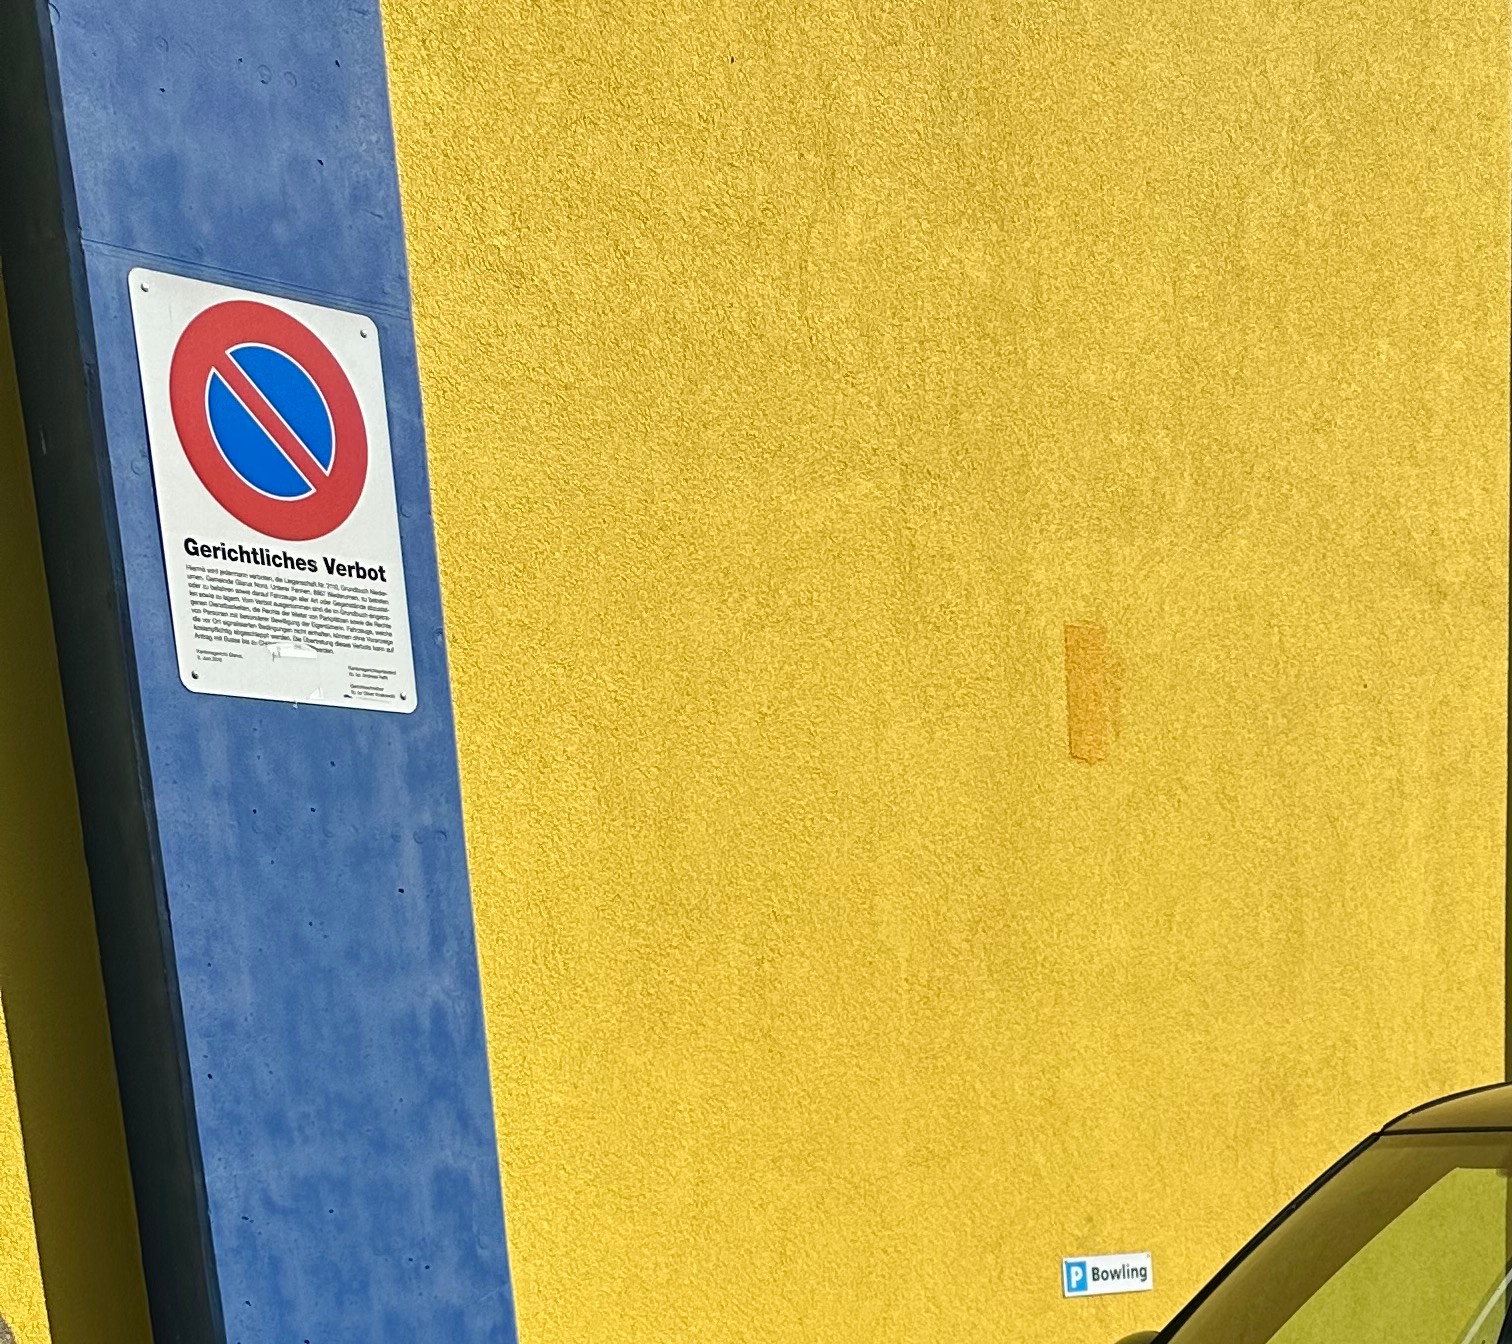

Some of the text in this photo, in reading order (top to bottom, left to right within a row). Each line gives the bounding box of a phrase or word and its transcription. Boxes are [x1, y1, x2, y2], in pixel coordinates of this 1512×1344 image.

[183, 537, 387, 582] Gerichtliches Verbot
[1070, 1263, 1147, 1288] P Bowling
